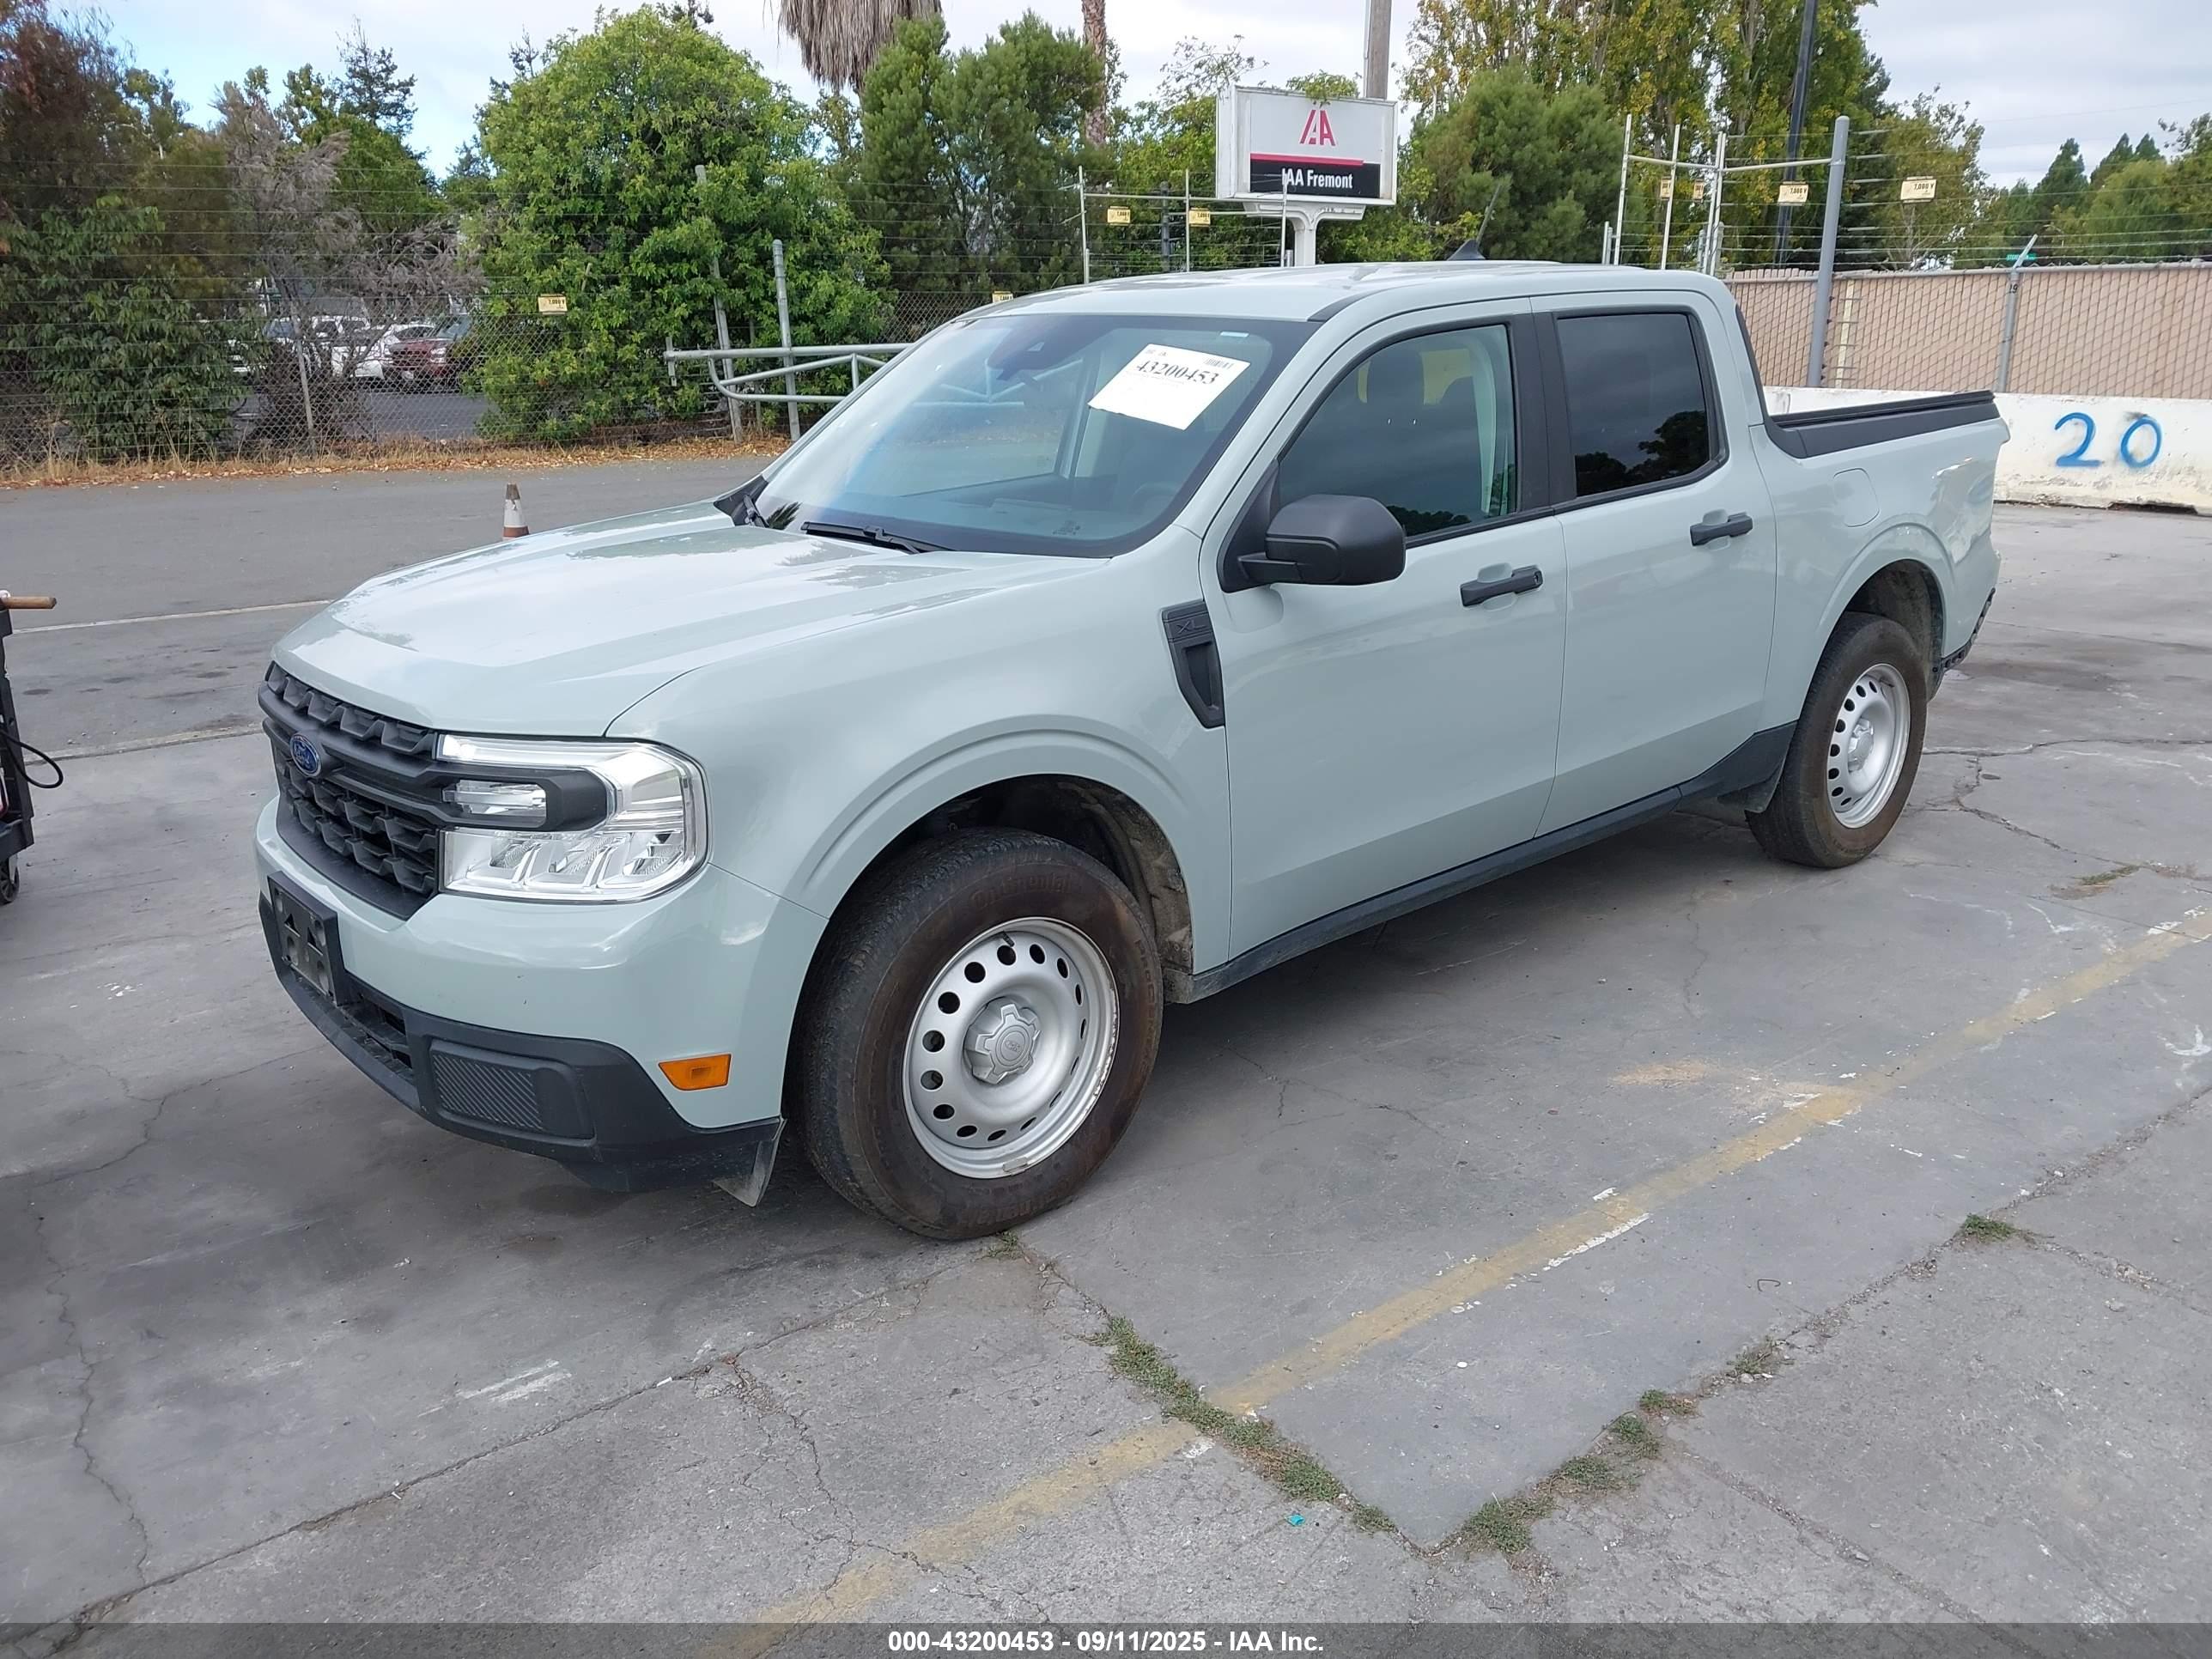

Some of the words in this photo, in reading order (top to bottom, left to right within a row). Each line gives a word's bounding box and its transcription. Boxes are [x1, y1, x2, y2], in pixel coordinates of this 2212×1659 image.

[1282, 167, 1304, 186] IAA
[1307, 169, 1352, 189] Fremont
[1136, 360, 1219, 384] 43200453
[2054, 411, 2162, 469] 20
